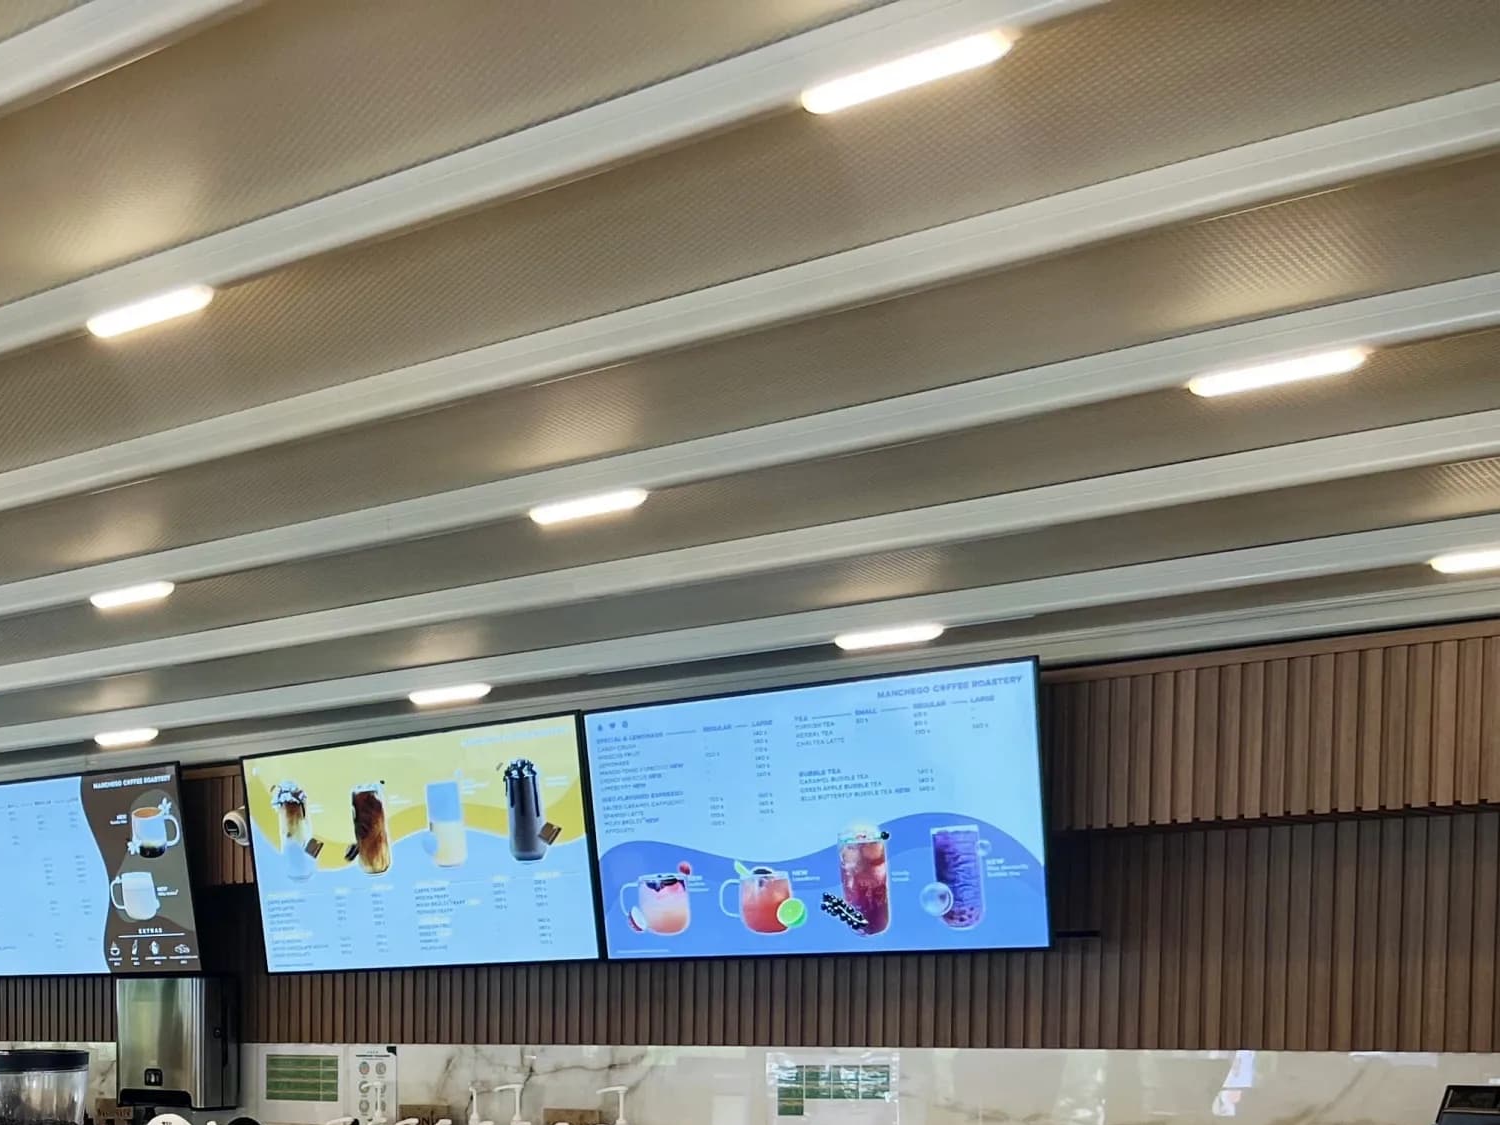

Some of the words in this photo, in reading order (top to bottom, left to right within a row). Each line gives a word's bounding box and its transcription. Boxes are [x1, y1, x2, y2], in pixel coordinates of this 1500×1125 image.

[877, 686, 930, 699] MANCHEGO
[933, 682, 969, 692] COFFEE
[972, 676, 1022, 689] ROASTERY
[913, 701, 946, 709] REGULAR
[970, 695, 995, 703] LARGE
[799, 769, 826, 777] BUBBLE
